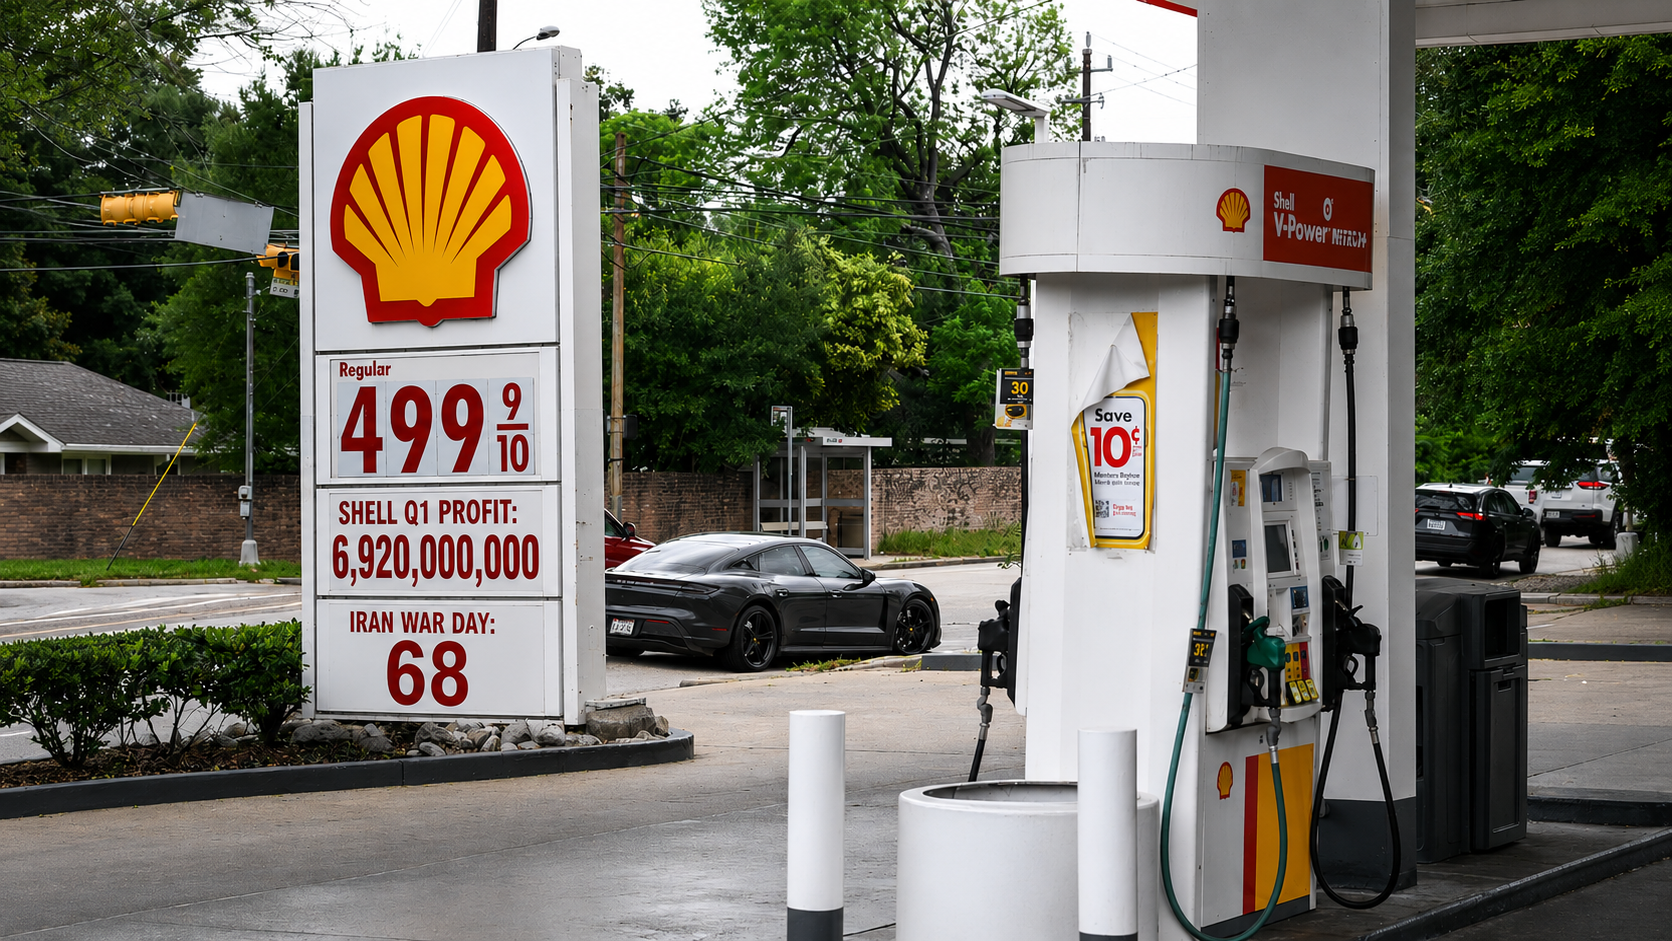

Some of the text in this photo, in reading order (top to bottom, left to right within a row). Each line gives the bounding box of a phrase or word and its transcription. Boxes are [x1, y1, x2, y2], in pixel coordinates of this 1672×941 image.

[1273, 191, 1295, 211] Shell
[1273, 211, 1328, 244] V-Power
[339, 360, 392, 381] Regular
[1011, 381, 1029, 395] 30
[340, 383, 484, 474] 499
[1094, 407, 1132, 423] Save
[496, 434, 530, 473] 10
[338, 499, 518, 526] SHELL Q1 PROFIT:
[332, 534, 540, 588] 6,920,000,000
[349, 611, 496, 635] IRAN WAR DAY:
[386, 639, 469, 707] 68
